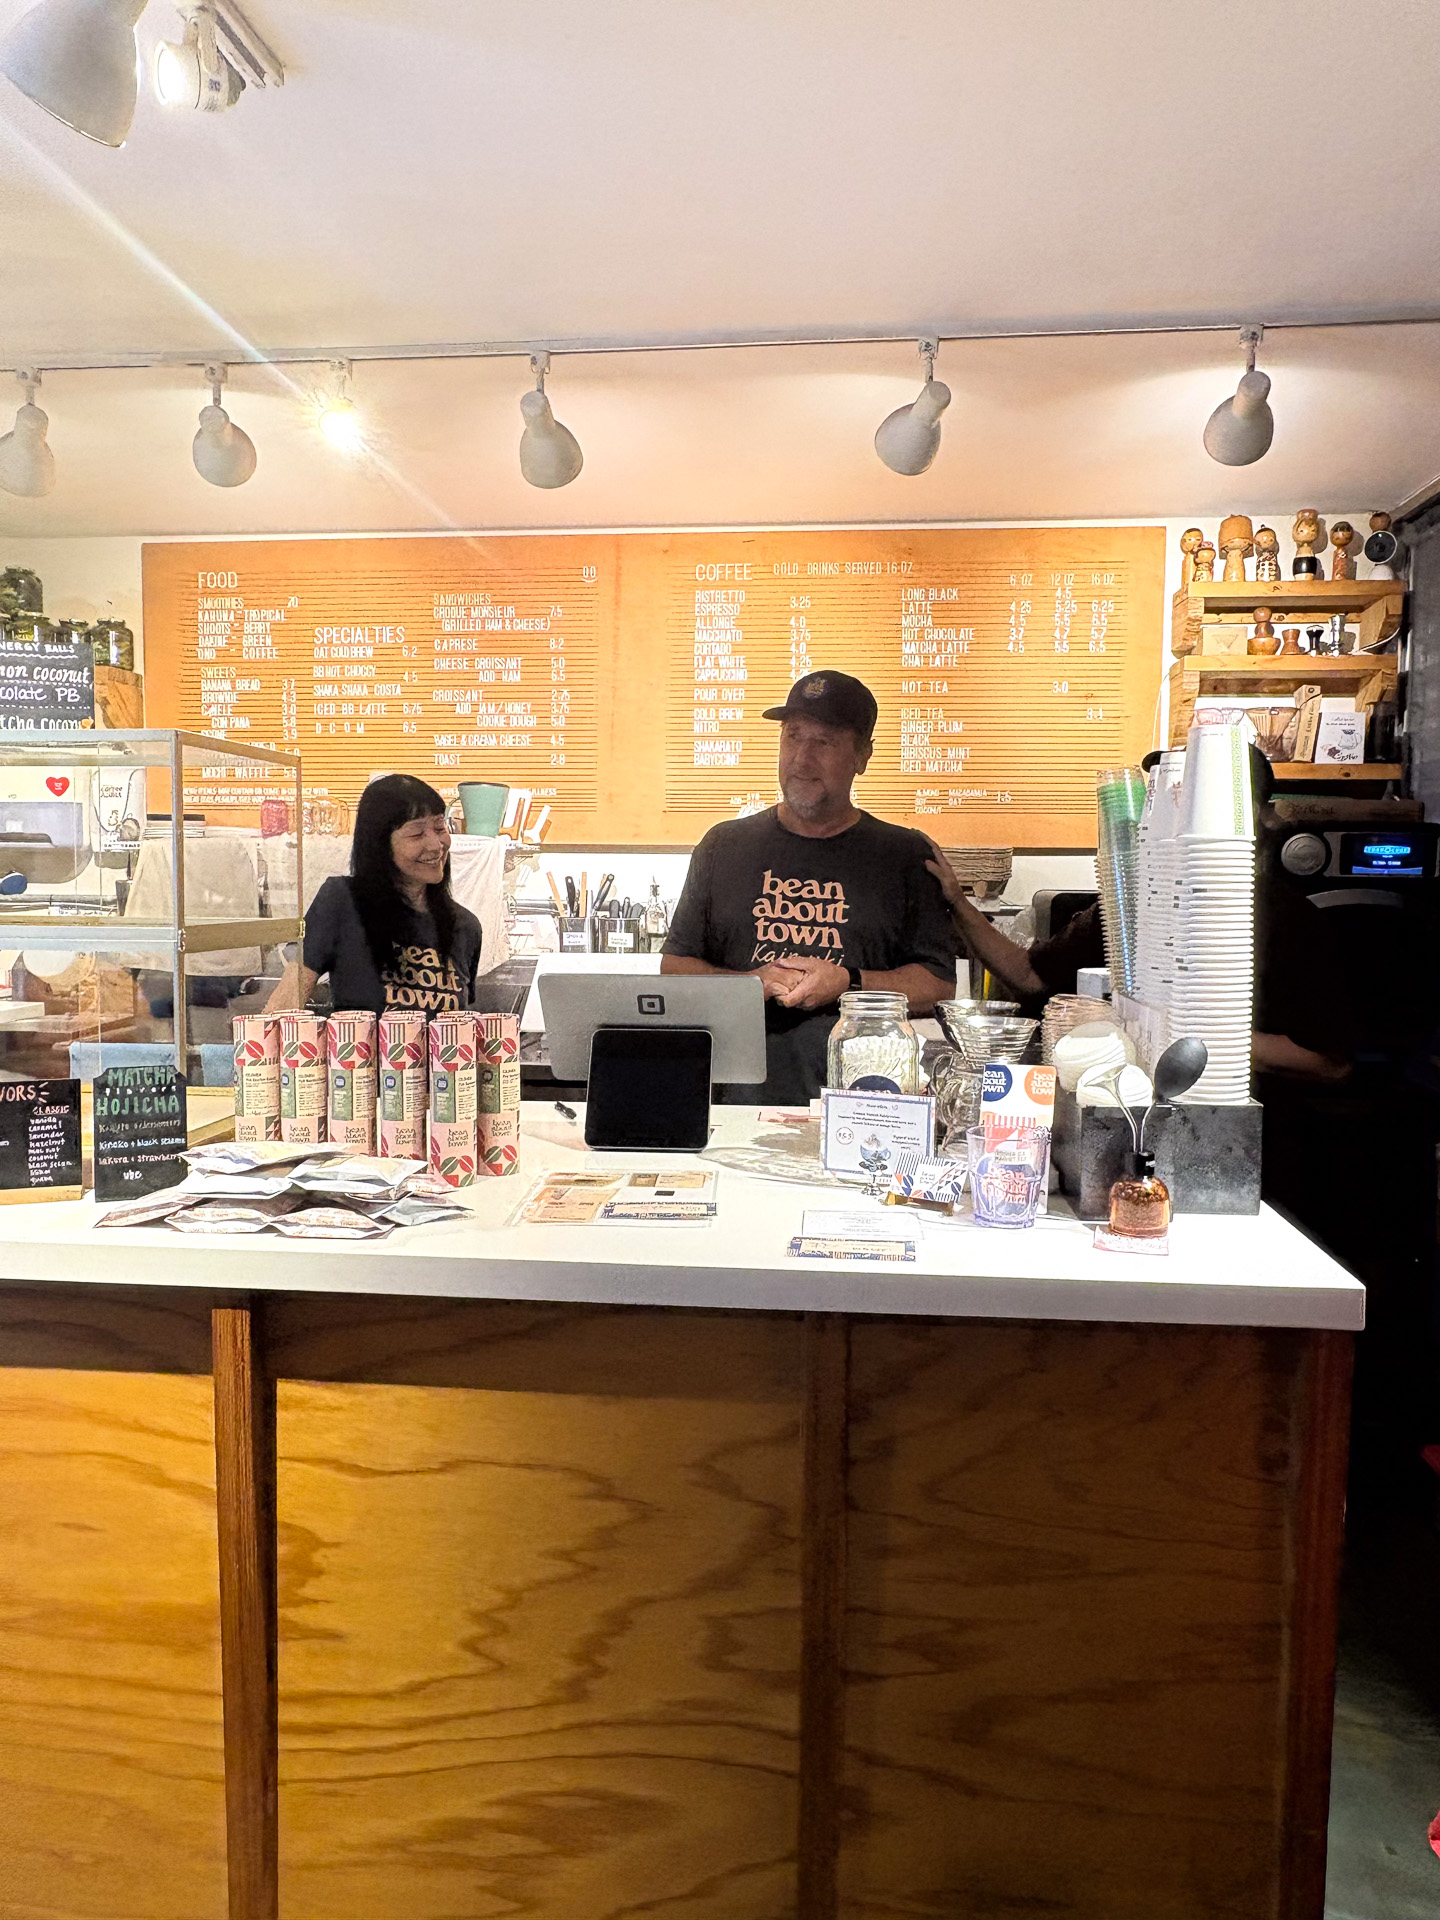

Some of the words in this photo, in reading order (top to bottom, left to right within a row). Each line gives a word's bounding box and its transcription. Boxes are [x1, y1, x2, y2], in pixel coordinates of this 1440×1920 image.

[695, 563, 752, 581] COFFEE
[773, 562, 799, 576] COLD
[807, 562, 840, 575] DRINKS
[844, 562, 882, 575] SERVED
[886, 562, 898, 575] 16
[900, 561, 913, 574] OZ
[198, 571, 238, 589] FOOD
[1021, 574, 1033, 586] OZ
[1050, 574, 1061, 586] 12
[1064, 574, 1075, 586] OZ
[1091, 573, 1100, 586] 16
[1103, 573, 1115, 585] OZ
[434, 593, 491, 605] SANDWICHES
[695, 590, 745, 603] RISTRETTO
[901, 588, 925, 600] LONG
[929, 588, 958, 600] BLACK
[1055, 587, 1072, 599] 4.5
[790, 596, 811, 608] 3.25
[902, 602, 933, 614] LATTE
[1009, 601, 1032, 613] 4.25
[1055, 600, 1077, 613] 5.25
[1091, 600, 1115, 612] 6.25
[243, 609, 287, 621] TROPICAL
[471, 606, 515, 618] MONSIEUR
[550, 606, 563, 617] 7.5
[694, 604, 740, 616] ESPRESSO
[441, 618, 481, 631] (GRILLED
[485, 619, 503, 631] HAM
[512, 617, 550, 631] CHEESE)
[695, 616, 736, 629] ALLONGE
[790, 616, 806, 628] 4.0
[902, 615, 933, 627] MOCHA
[1009, 614, 1026, 626] 4.5
[1054, 614, 1071, 626] 5.5
[1091, 614, 1108, 626] 6.5
[198, 623, 231, 635] SHOOTS
[243, 622, 271, 634] BERRY
[902, 628, 920, 640] HOT
[924, 627, 975, 640] CHOCOLATE
[1009, 628, 1025, 641] 3.7
[1054, 627, 1070, 640] 4.7
[1091, 627, 1107, 640] 5.7
[242, 635, 272, 646] GREEN
[313, 626, 405, 644] SPECIALTIES
[695, 630, 742, 642] MACCHIATO
[790, 629, 811, 641] 3.75
[44, 643, 75, 653] BALLS
[434, 639, 478, 651] CAPRESE
[550, 638, 564, 649] 8.2
[694, 643, 732, 655] CORTADO
[790, 642, 806, 654] 4.0
[902, 641, 937, 654] MATCHA
[942, 641, 970, 653] LATTE
[1007, 641, 1025, 653] 4.5
[1054, 640, 1070, 653] 5.5
[1089, 641, 1106, 653] 6.5
[242, 647, 279, 659] COFFEE
[313, 647, 329, 658] OAT
[330, 647, 349, 658] COLD
[350, 646, 374, 658] BREW
[402, 645, 418, 657] 6.2
[434, 658, 470, 670] CHEESE
[474, 657, 522, 669] CROISSANT
[551, 656, 565, 668] 5.0
[694, 656, 715, 668] FLAT
[718, 656, 747, 668] WHITE
[789, 655, 812, 667] 4.25
[902, 655, 923, 667] CHAI
[929, 654, 960, 667] LATTE
[33, 667, 92, 683] coconut
[201, 667, 236, 678] SWEETS
[313, 666, 325, 678] BB
[325, 665, 341, 677] HOT
[479, 670, 496, 682] ADD
[502, 670, 521, 682] HAM
[551, 670, 566, 681] 6.5
[694, 669, 748, 681] CAPPUCCINO
[201, 680, 233, 691] BANANA
[236, 679, 261, 690] BREAD
[313, 685, 339, 696] SHAKA
[341, 684, 368, 696] SHAKA
[374, 684, 401, 695] COSTA
[901, 681, 923, 693] HOT
[930, 681, 949, 693] TEA
[1053, 681, 1069, 693] 3.0
[55, 688, 81, 702] PB
[201, 692, 239, 703] BROWNIE
[432, 690, 483, 702] CROISSANT
[551, 689, 570, 701] 2.75
[694, 688, 718, 700] POUR
[721, 688, 745, 700] OVER
[313, 703, 336, 715] ICED
[341, 703, 354, 715] BB
[359, 703, 389, 715] LATTE
[402, 703, 422, 715] 6.75
[455, 703, 471, 714] ADD
[550, 702, 570, 714] 3.75
[694, 708, 716, 720] COLD
[718, 708, 743, 720] BREW
[901, 708, 921, 719] ICED
[927, 708, 944, 719] TEA
[229, 717, 250, 728] PANA
[477, 715, 507, 727] COOKIE
[510, 715, 537, 727] DOUGH
[551, 715, 566, 726] 5.0
[694, 721, 719, 733] NITRO
[901, 721, 934, 733] GINGER
[938, 721, 963, 732] PLUM
[402, 722, 417, 733] 6.5
[434, 734, 459, 746] BAGEL
[468, 734, 498, 746] CREAM
[499, 734, 533, 746] CHEESE
[550, 734, 565, 746] 4.5
[901, 734, 930, 746] BLACK
[694, 741, 742, 752] SHAKARATO
[694, 753, 739, 765] BABYCCINO
[901, 747, 942, 759] HIBISCUS
[947, 747, 971, 759] MINT
[434, 754, 461, 765] TOAST
[551, 754, 566, 765] 2.8
[901, 760, 921, 772] ICED
[925, 760, 963, 772] MATCHA
[234, 767, 271, 778] WAFFLE
[762, 869, 845, 900] bean
[752, 893, 850, 924] about
[754, 917, 844, 949] town
[107, 1065, 177, 1087] MATCHA
[33, 1105, 70, 1115] CLASSIC
[95, 1095, 180, 1116] HOJICHA
[29, 1121, 62, 1131] caramel
[29, 1138, 65, 1148] hazelnut
[123, 1169, 143, 1180] ube
